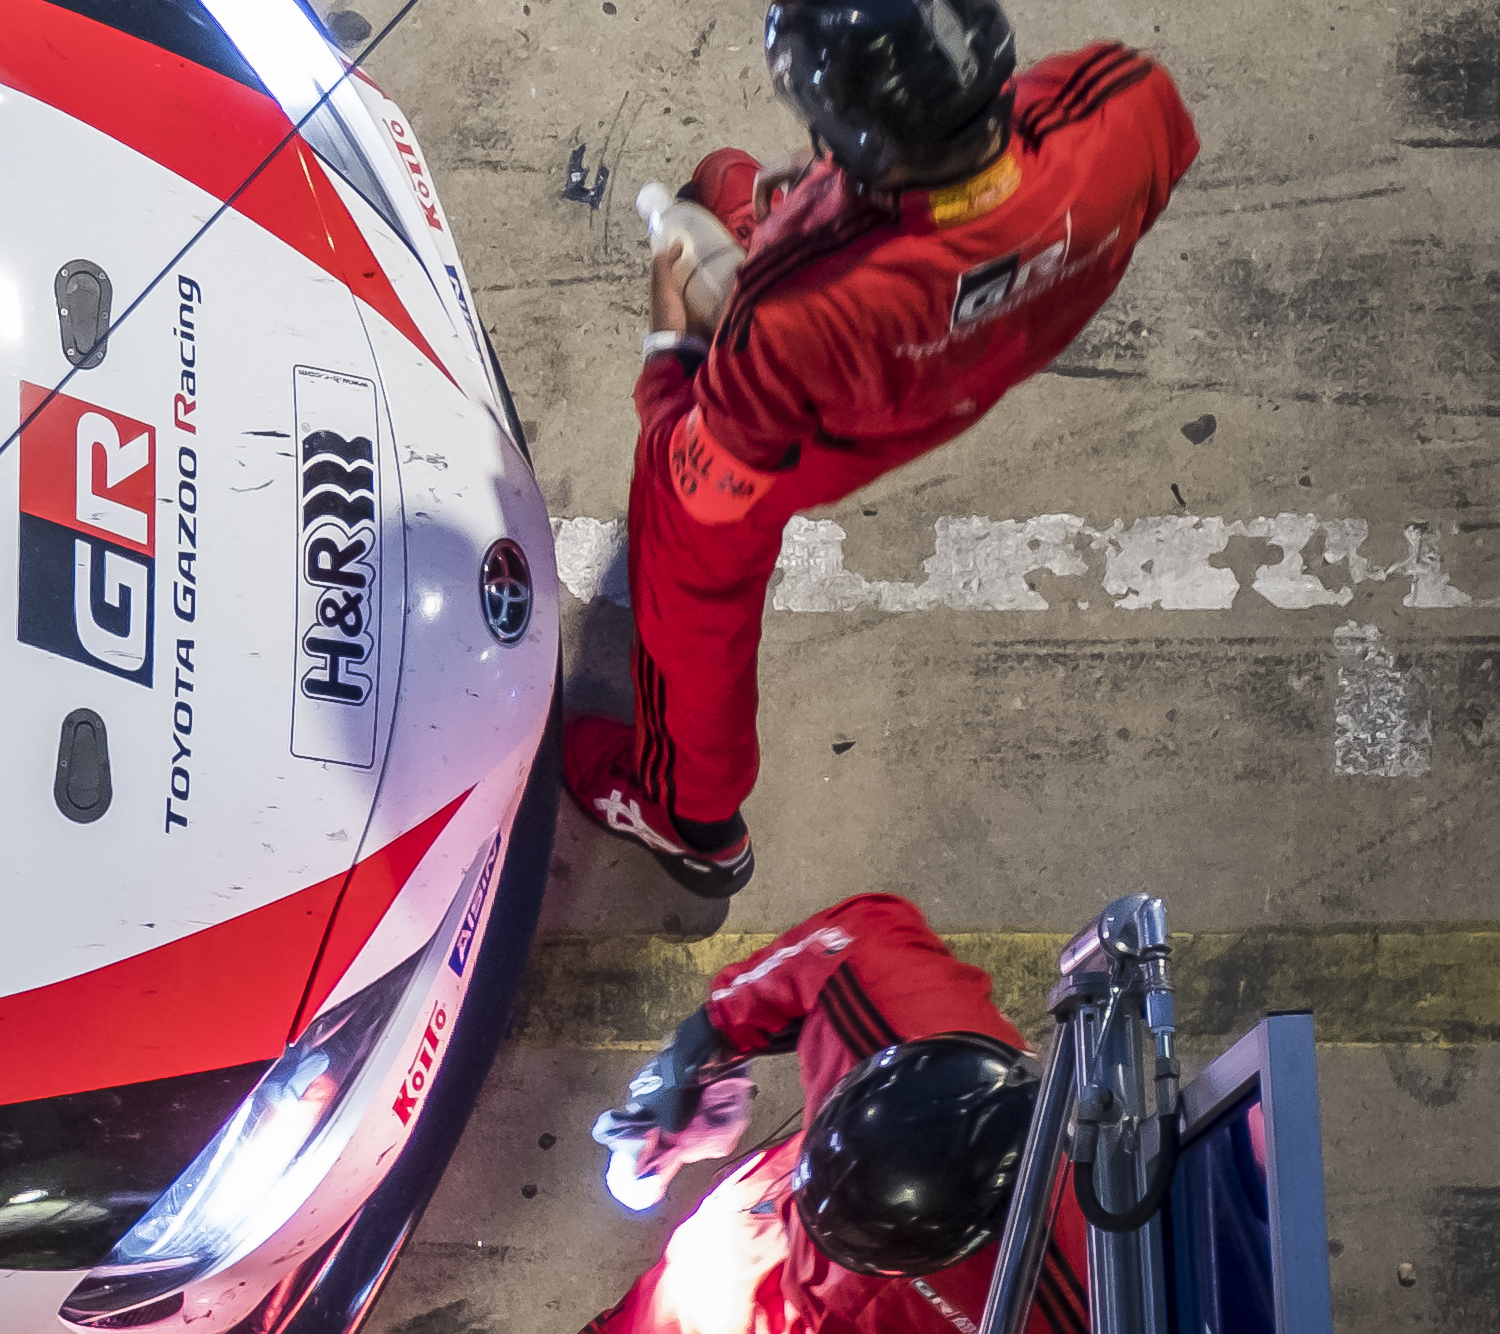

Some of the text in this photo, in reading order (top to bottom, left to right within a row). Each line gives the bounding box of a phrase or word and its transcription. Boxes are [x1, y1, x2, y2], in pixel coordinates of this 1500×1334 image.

[73, 409, 151, 673] GR
[164, 273, 204, 836] TOYOTA GAZOO Racing
[301, 523, 377, 707] H&R
